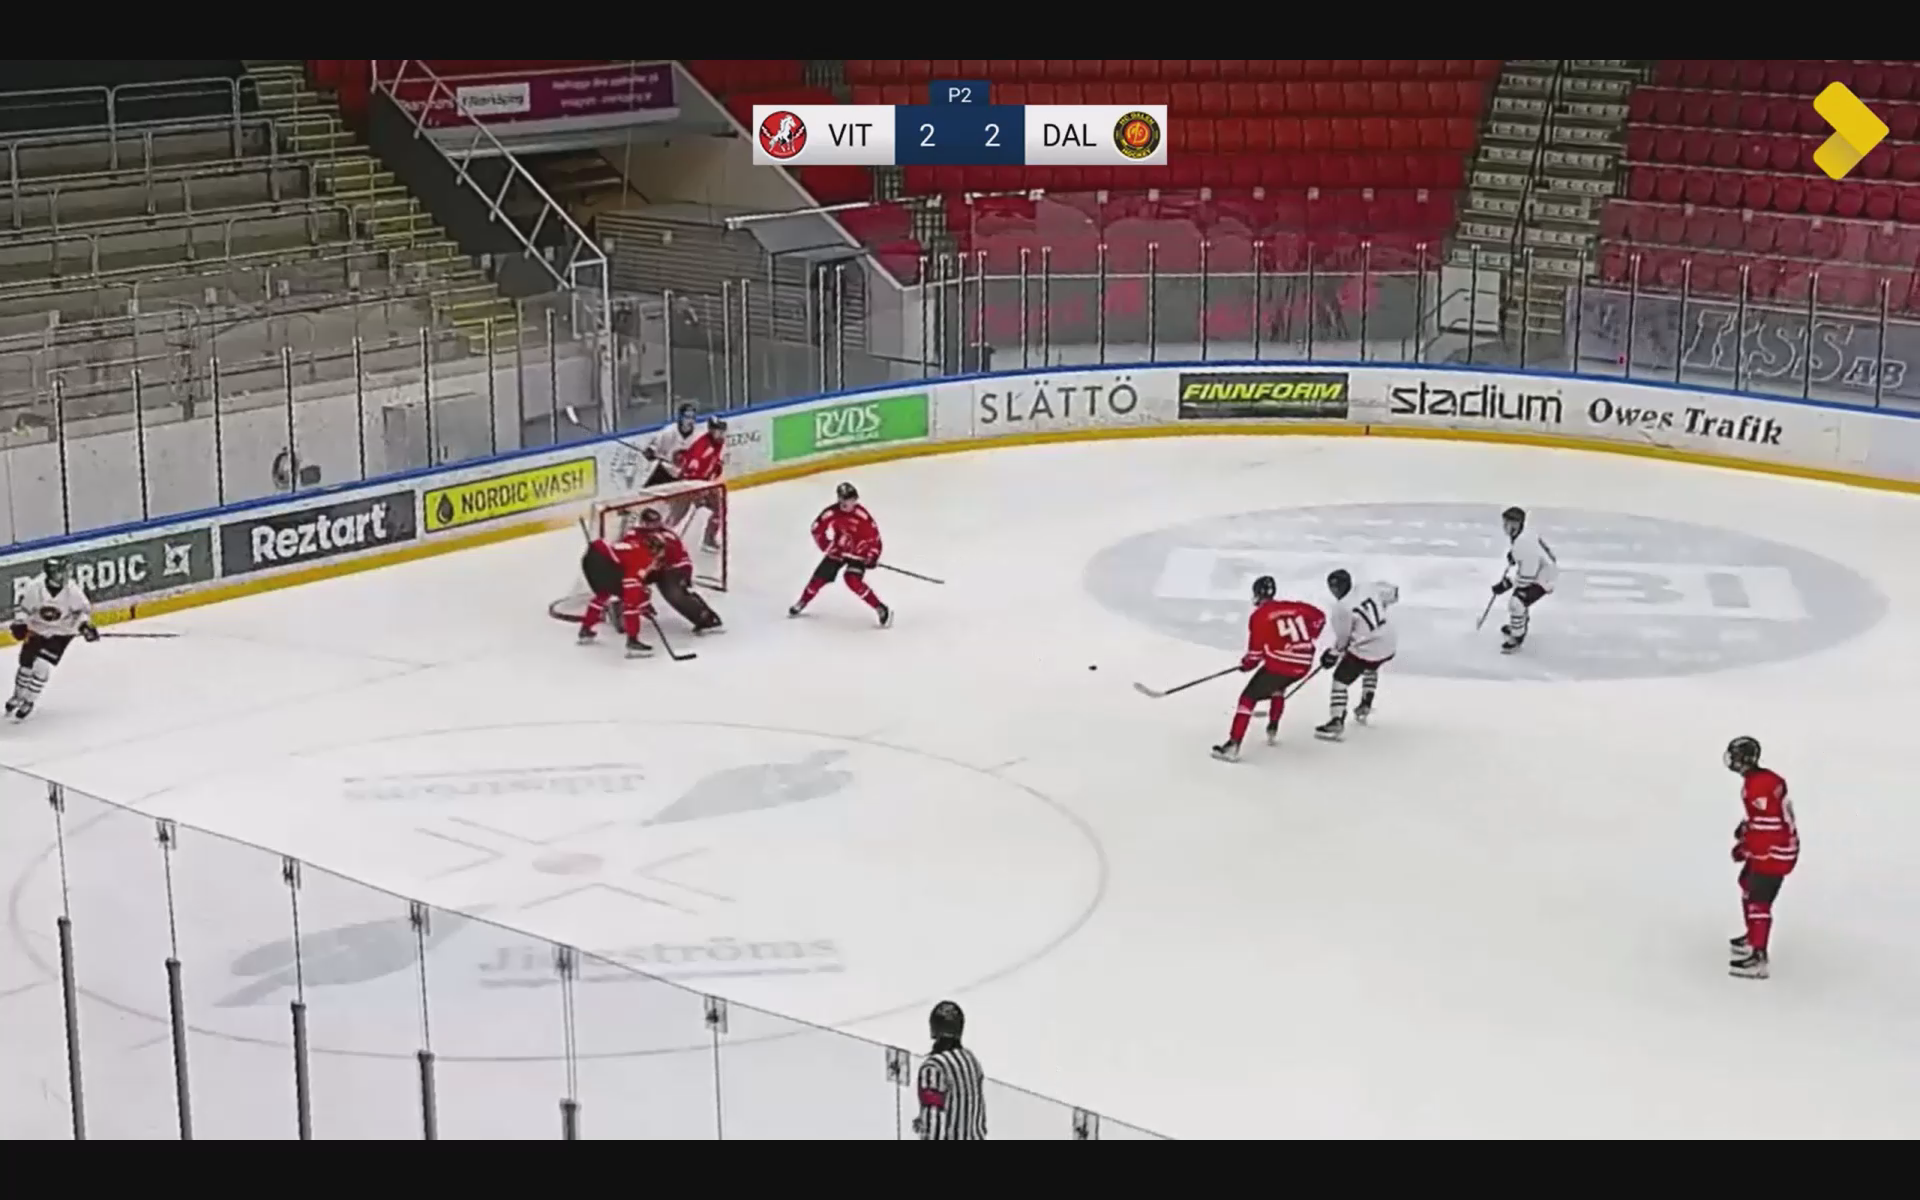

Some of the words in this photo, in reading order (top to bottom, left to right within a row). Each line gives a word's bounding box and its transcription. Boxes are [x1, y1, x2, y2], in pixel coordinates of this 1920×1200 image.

[979, 375, 1138, 424] SLÄTTÖ
[1182, 382, 1343, 400] FINNFORM
[1390, 381, 1563, 424] stadium
[815, 404, 880, 440] RYDS
[1588, 397, 1674, 430] Owes
[1684, 407, 1783, 446] Trafik
[461, 481, 528, 515] NORDIC
[531, 467, 585, 500] WASH
[251, 501, 387, 564] Reztart
[1276, 614, 1310, 643] 41
[1352, 597, 1387, 632] 12
